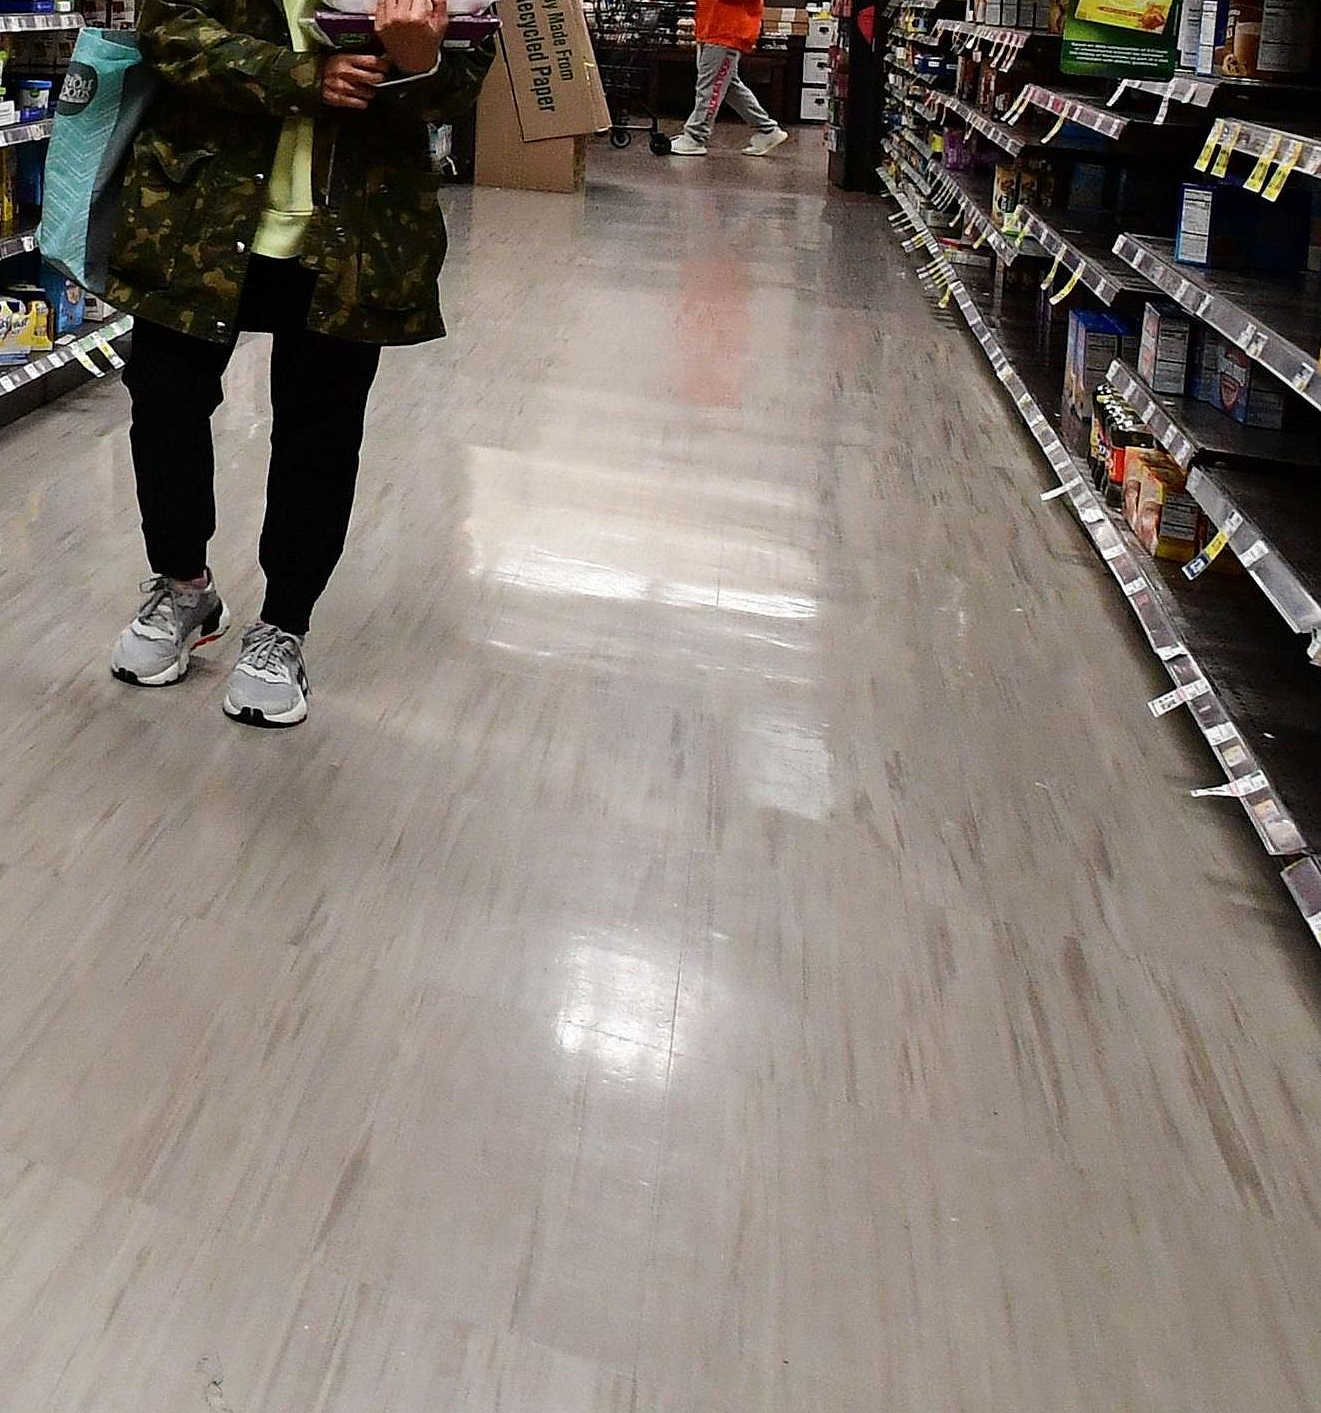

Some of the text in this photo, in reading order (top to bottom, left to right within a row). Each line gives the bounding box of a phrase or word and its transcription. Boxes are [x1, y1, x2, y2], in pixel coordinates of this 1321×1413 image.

[549, 12, 568, 47] Made
[556, 49, 574, 81] From
[531, 65, 556, 112] Paper
